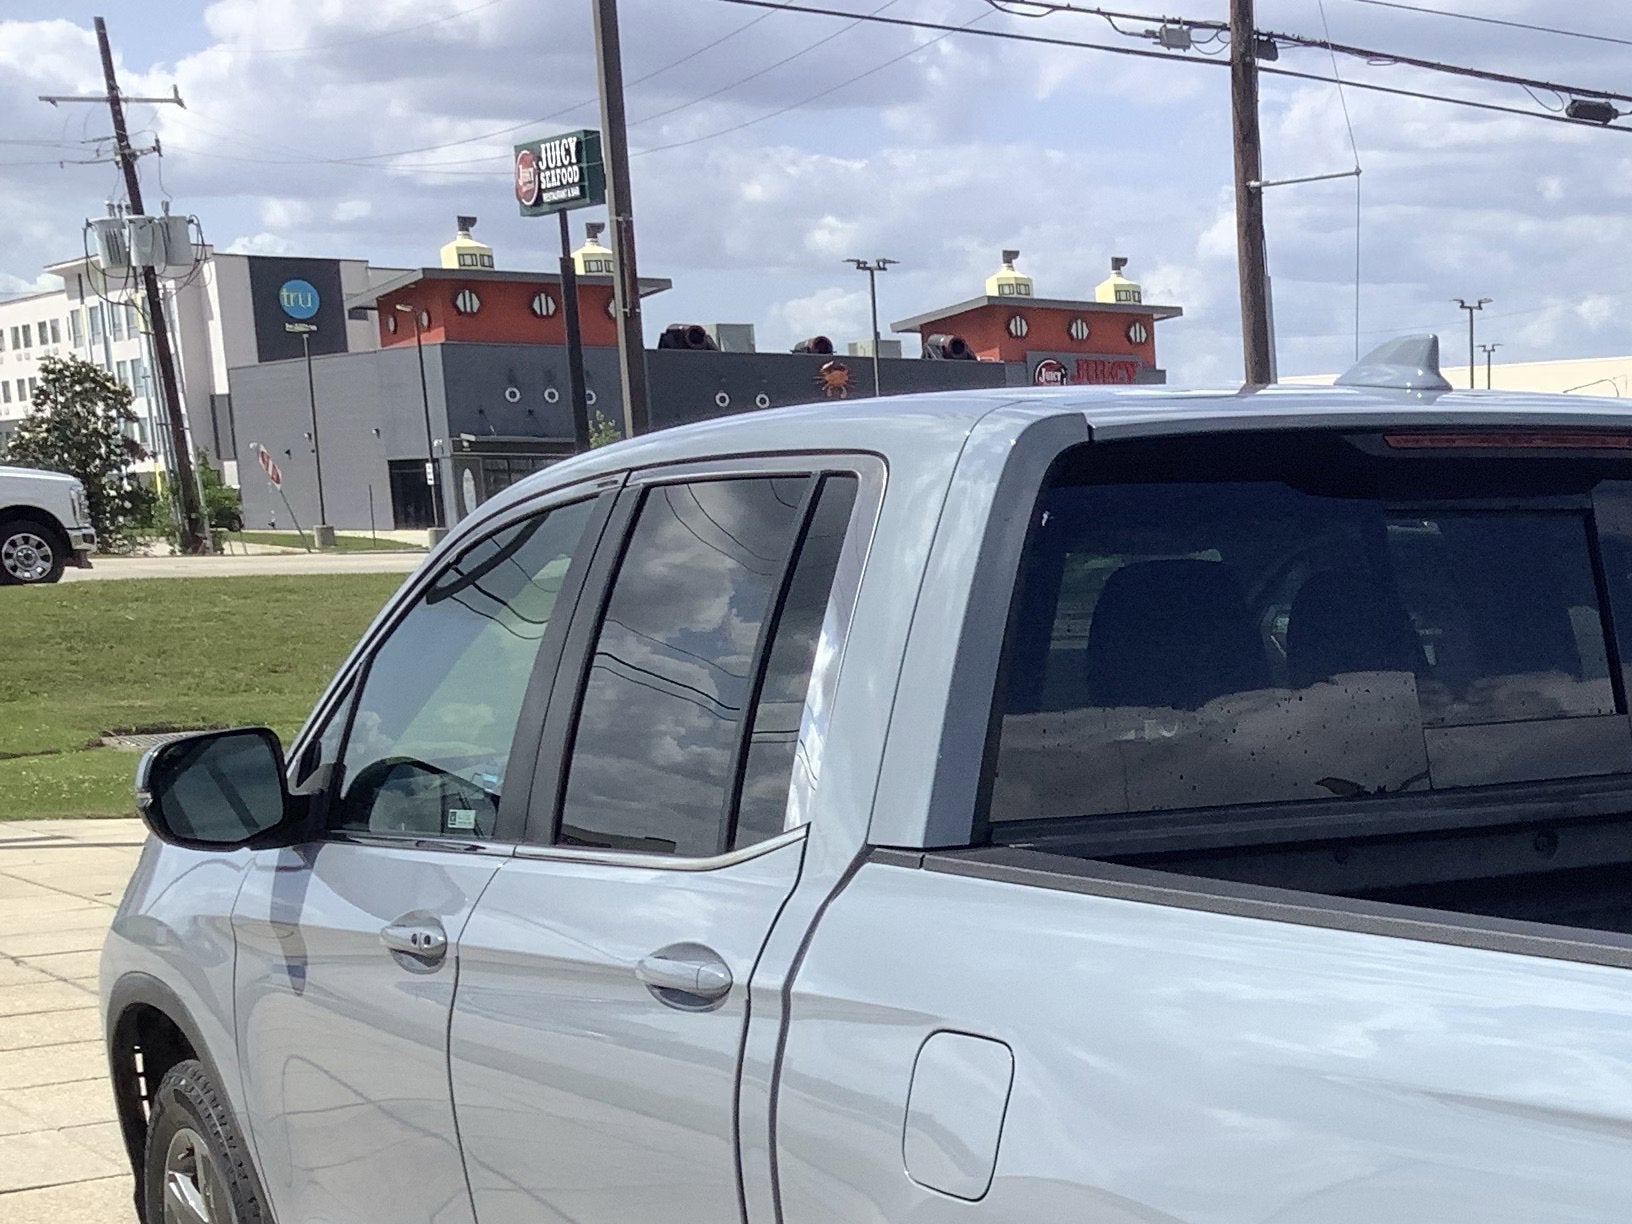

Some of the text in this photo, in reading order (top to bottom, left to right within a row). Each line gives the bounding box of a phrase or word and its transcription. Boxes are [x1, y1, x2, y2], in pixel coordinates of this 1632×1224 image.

[539, 137, 577, 170] JUICY
[540, 165, 580, 189] SEAFOOD
[281, 288, 312, 308] tru
